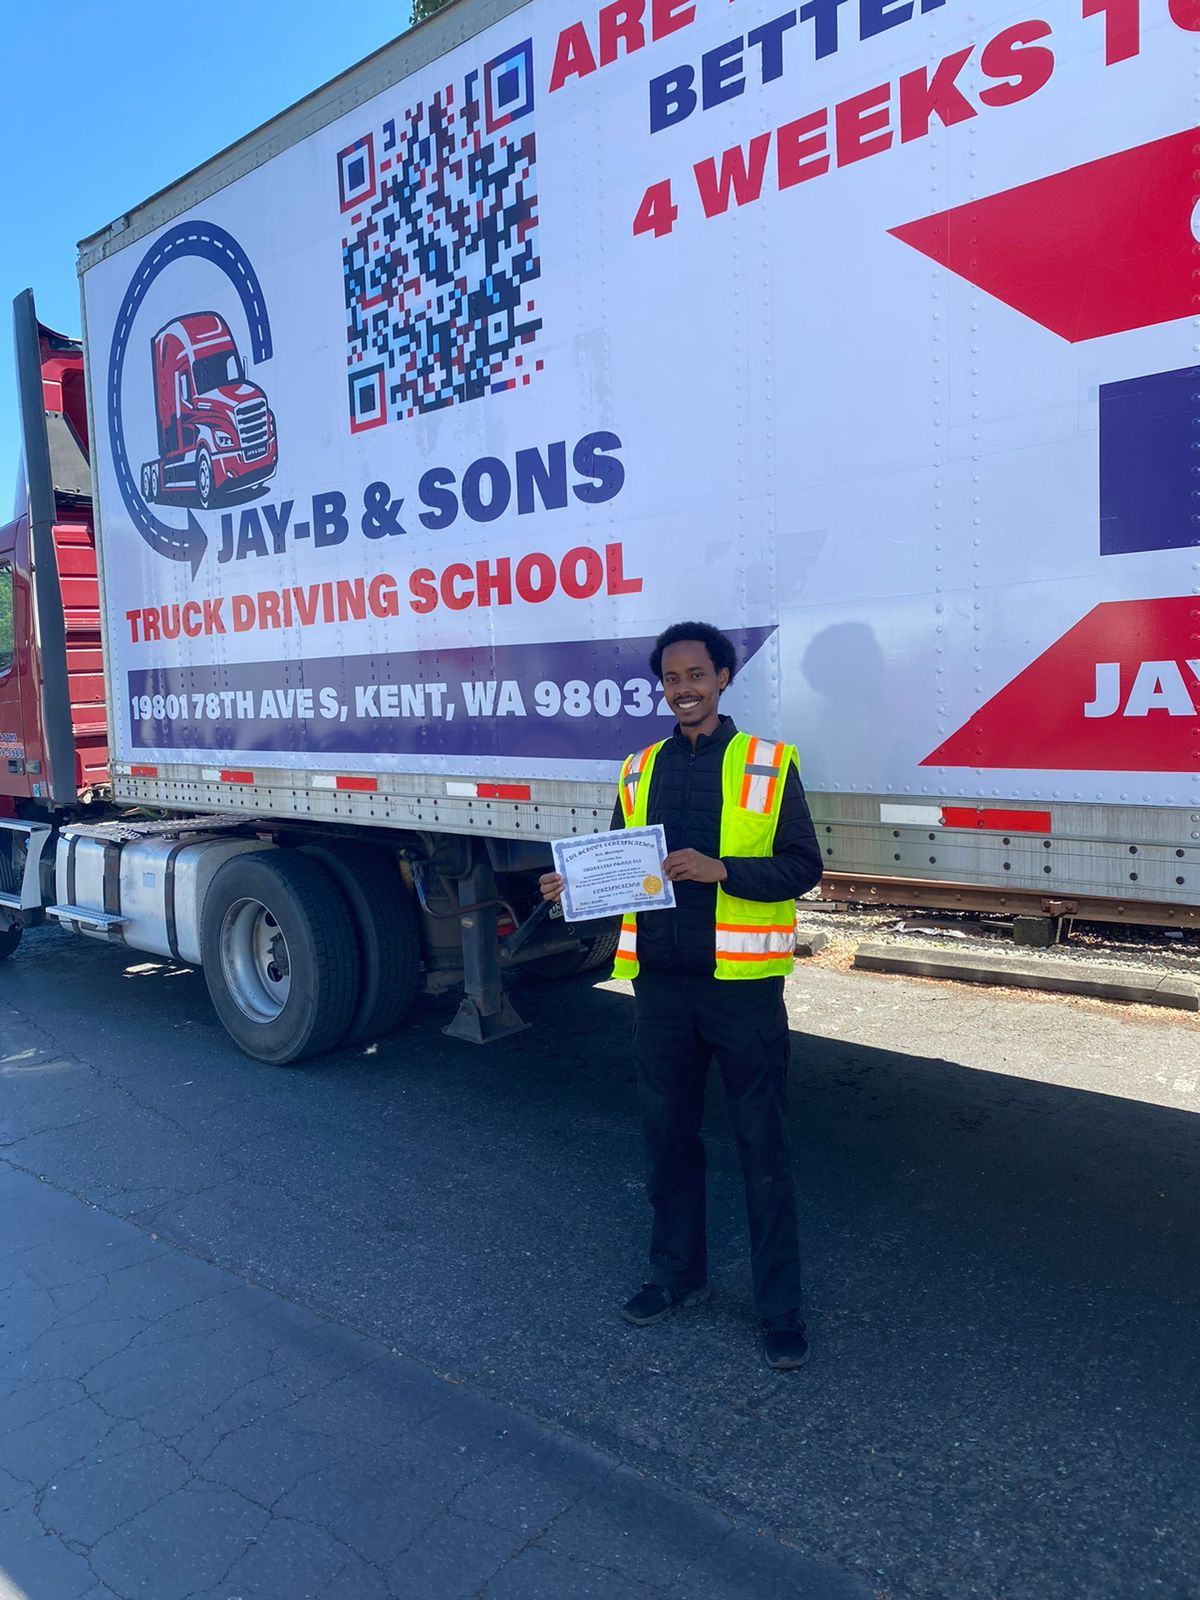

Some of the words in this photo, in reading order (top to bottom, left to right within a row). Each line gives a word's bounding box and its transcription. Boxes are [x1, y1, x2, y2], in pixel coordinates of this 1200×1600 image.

[650, 0, 946, 134] BETTE
[633, 180, 677, 237] 4
[694, 21, 1053, 218] WEEKS
[218, 491, 349, 563] JAY-B
[361, 481, 407, 539] &
[419, 431, 625, 530] SONS
[126, 598, 226, 643] TRUCK
[233, 574, 399, 631] DRIVING
[409, 544, 642, 614] SCHOOL
[132, 694, 188, 720] 19801
[192, 691, 254, 719] 78TH
[260, 688, 314, 718] AVE
[319, 687, 348, 721] S,
[355, 683, 455, 720] KENT,
[462, 681, 526, 716] WA
[1085, 659, 1200, 717] JA
